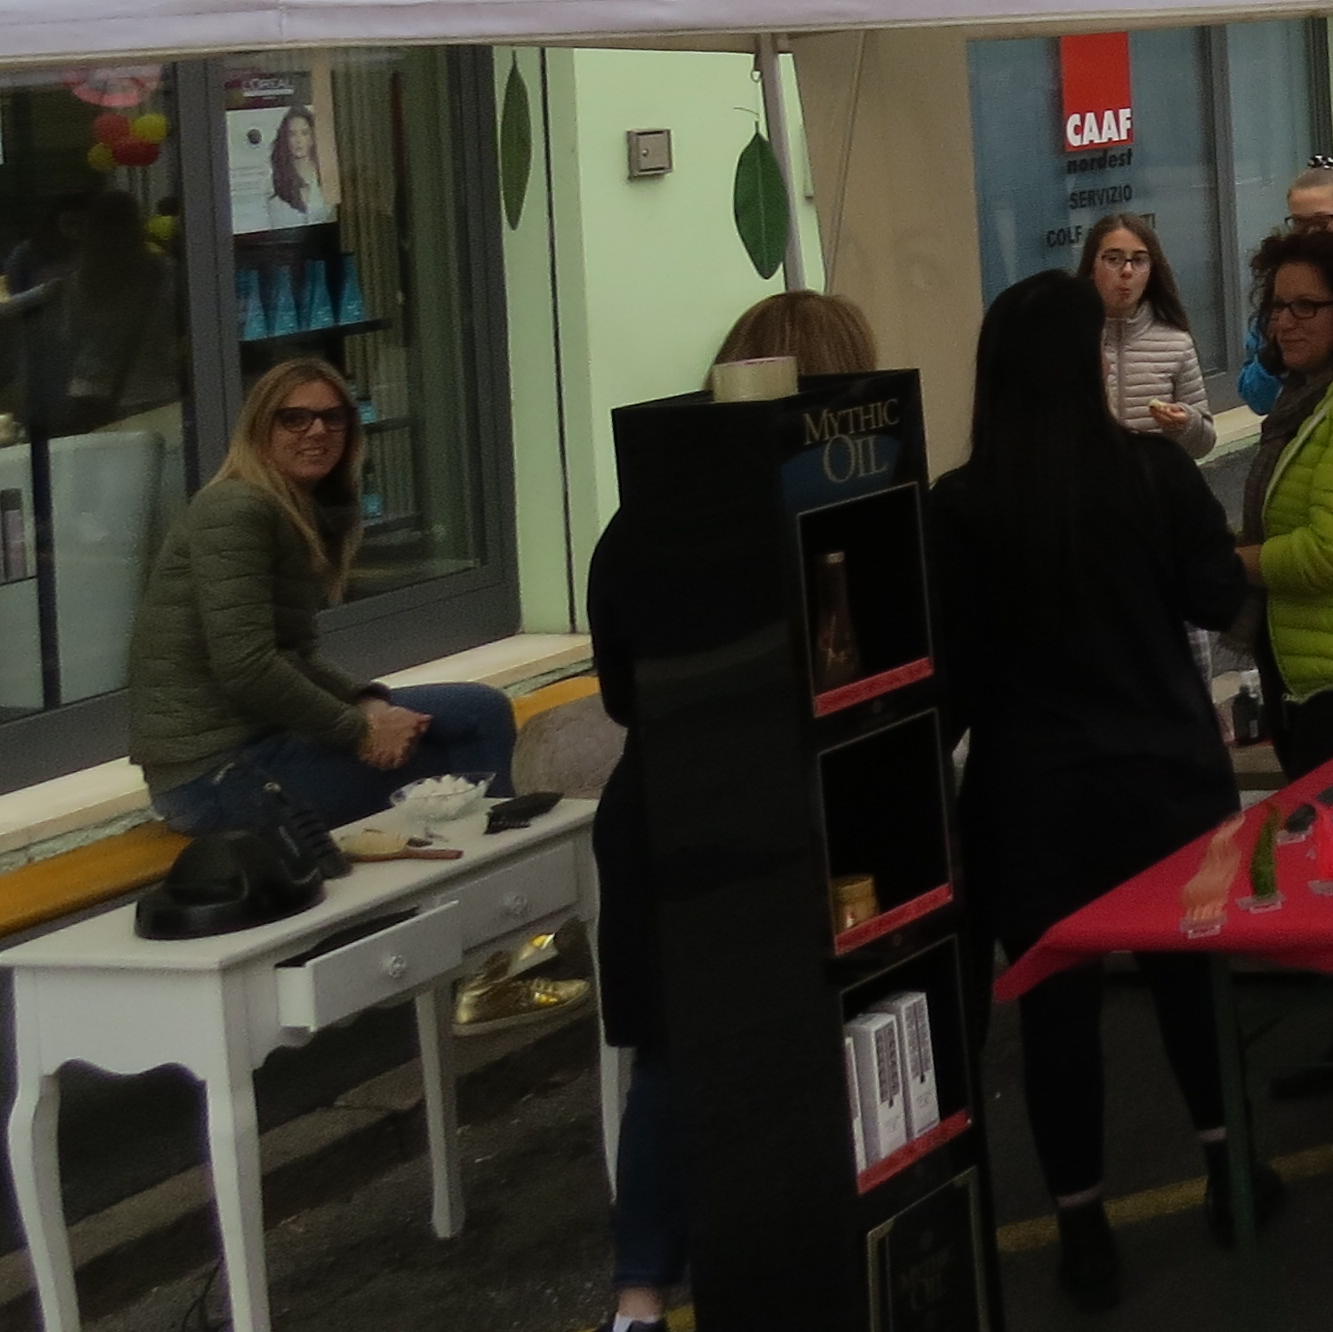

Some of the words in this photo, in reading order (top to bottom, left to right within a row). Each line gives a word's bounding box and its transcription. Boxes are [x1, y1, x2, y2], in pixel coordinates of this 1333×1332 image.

[1066, 108, 1132, 147] CAAF
[1067, 148, 1133, 174] nordest
[1069, 185, 1132, 210] SERVIZIO
[1046, 226, 1082, 248] COLF
[803, 398, 899, 445] MYTHIC
[823, 434, 889, 482] OIL
